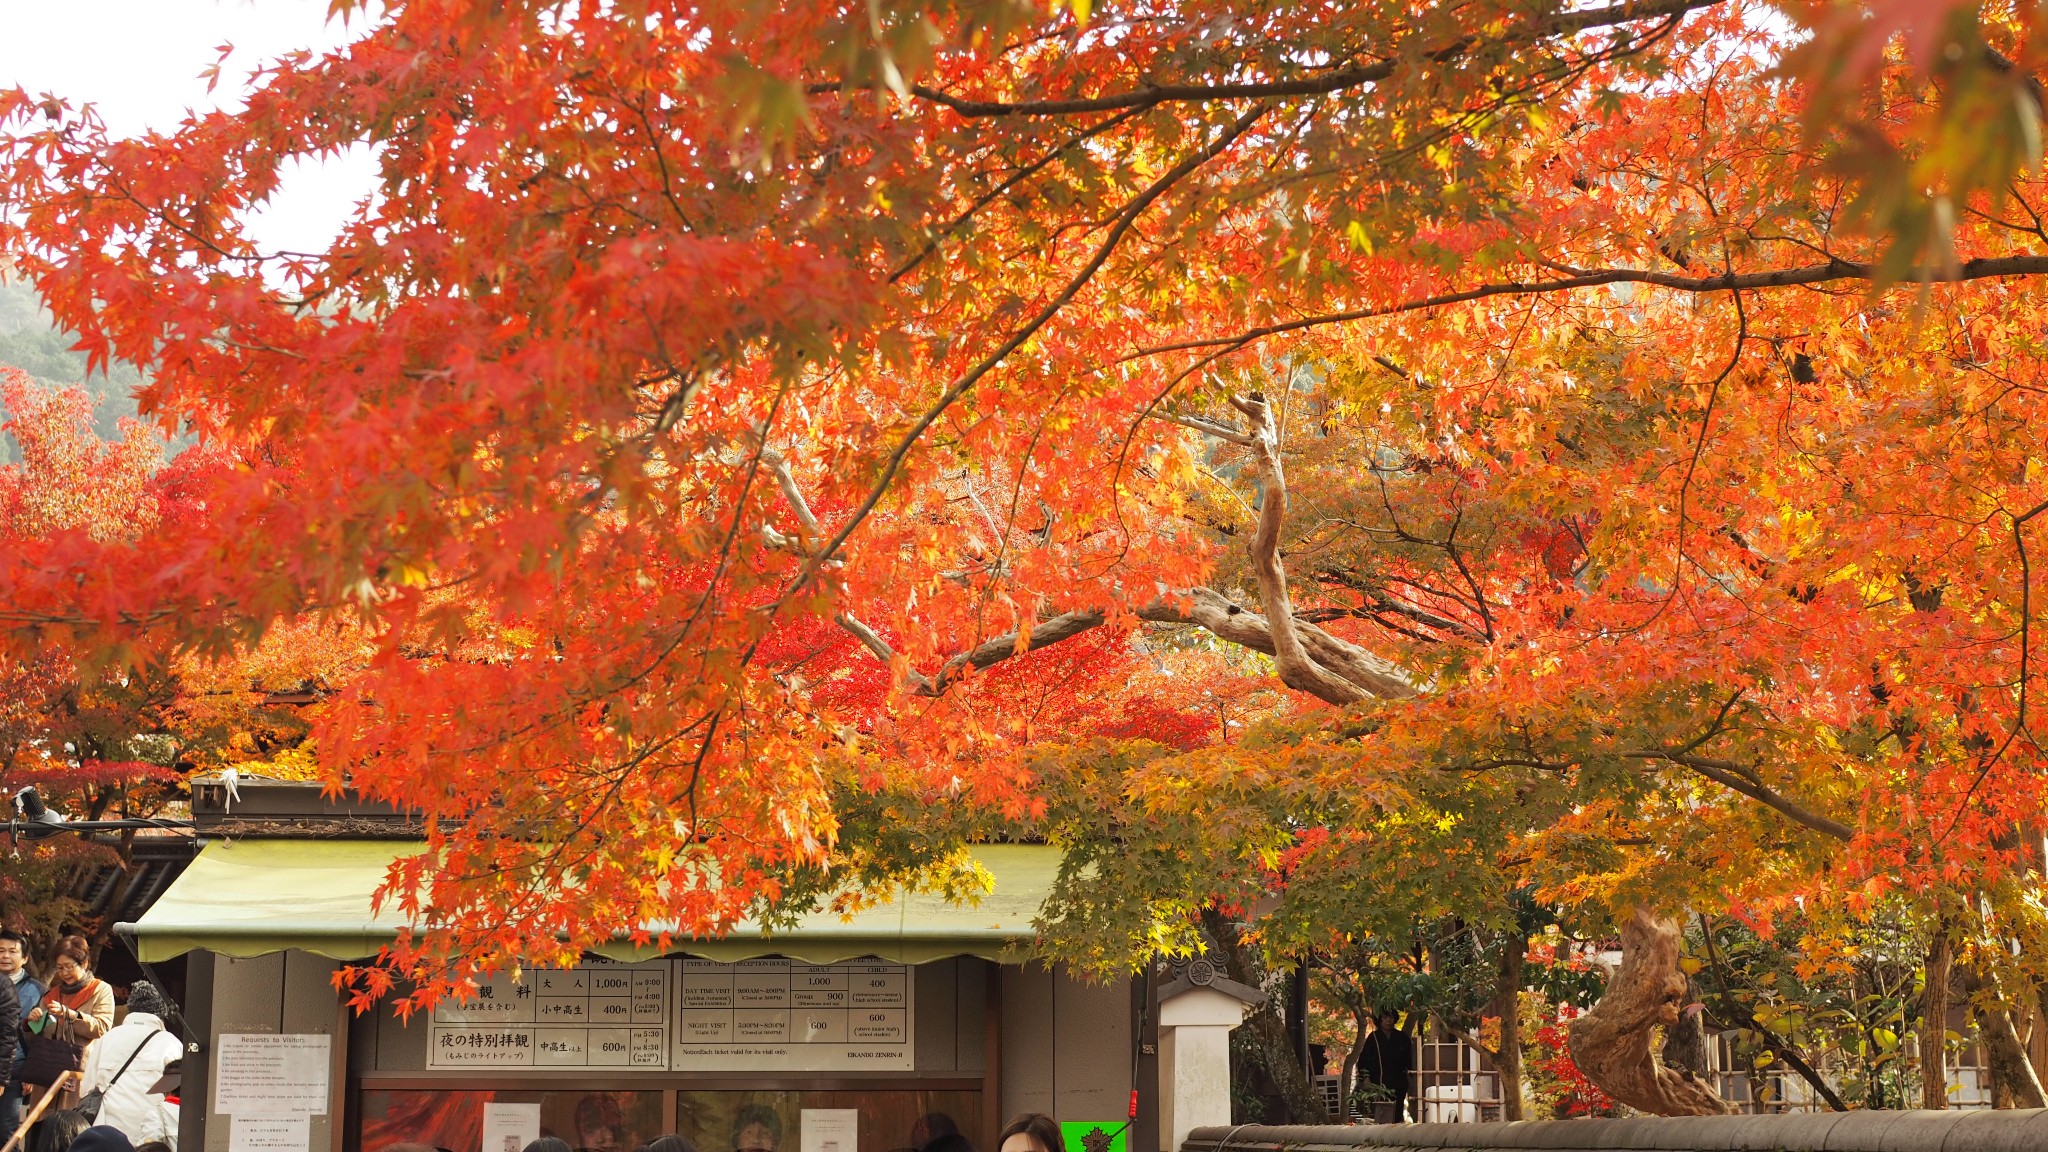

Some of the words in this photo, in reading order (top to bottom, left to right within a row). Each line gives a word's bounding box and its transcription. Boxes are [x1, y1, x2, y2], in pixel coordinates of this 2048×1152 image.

[596, 979, 628, 989] 1,000円
[645, 978, 661, 986] 9:00
[808, 977, 831, 986] 1,000
[869, 980, 886, 988] 400
[542, 1005, 583, 1015] 小中高生
[603, 1005, 627, 1014] 400円
[869, 1014, 886, 1022] 600
[811, 1022, 827, 1030] 600
[440, 1033, 530, 1048] 夜の特別拝観
[602, 1043, 626, 1052] 600円
[445, 1052, 524, 1060] (もみじのライトアップ)
